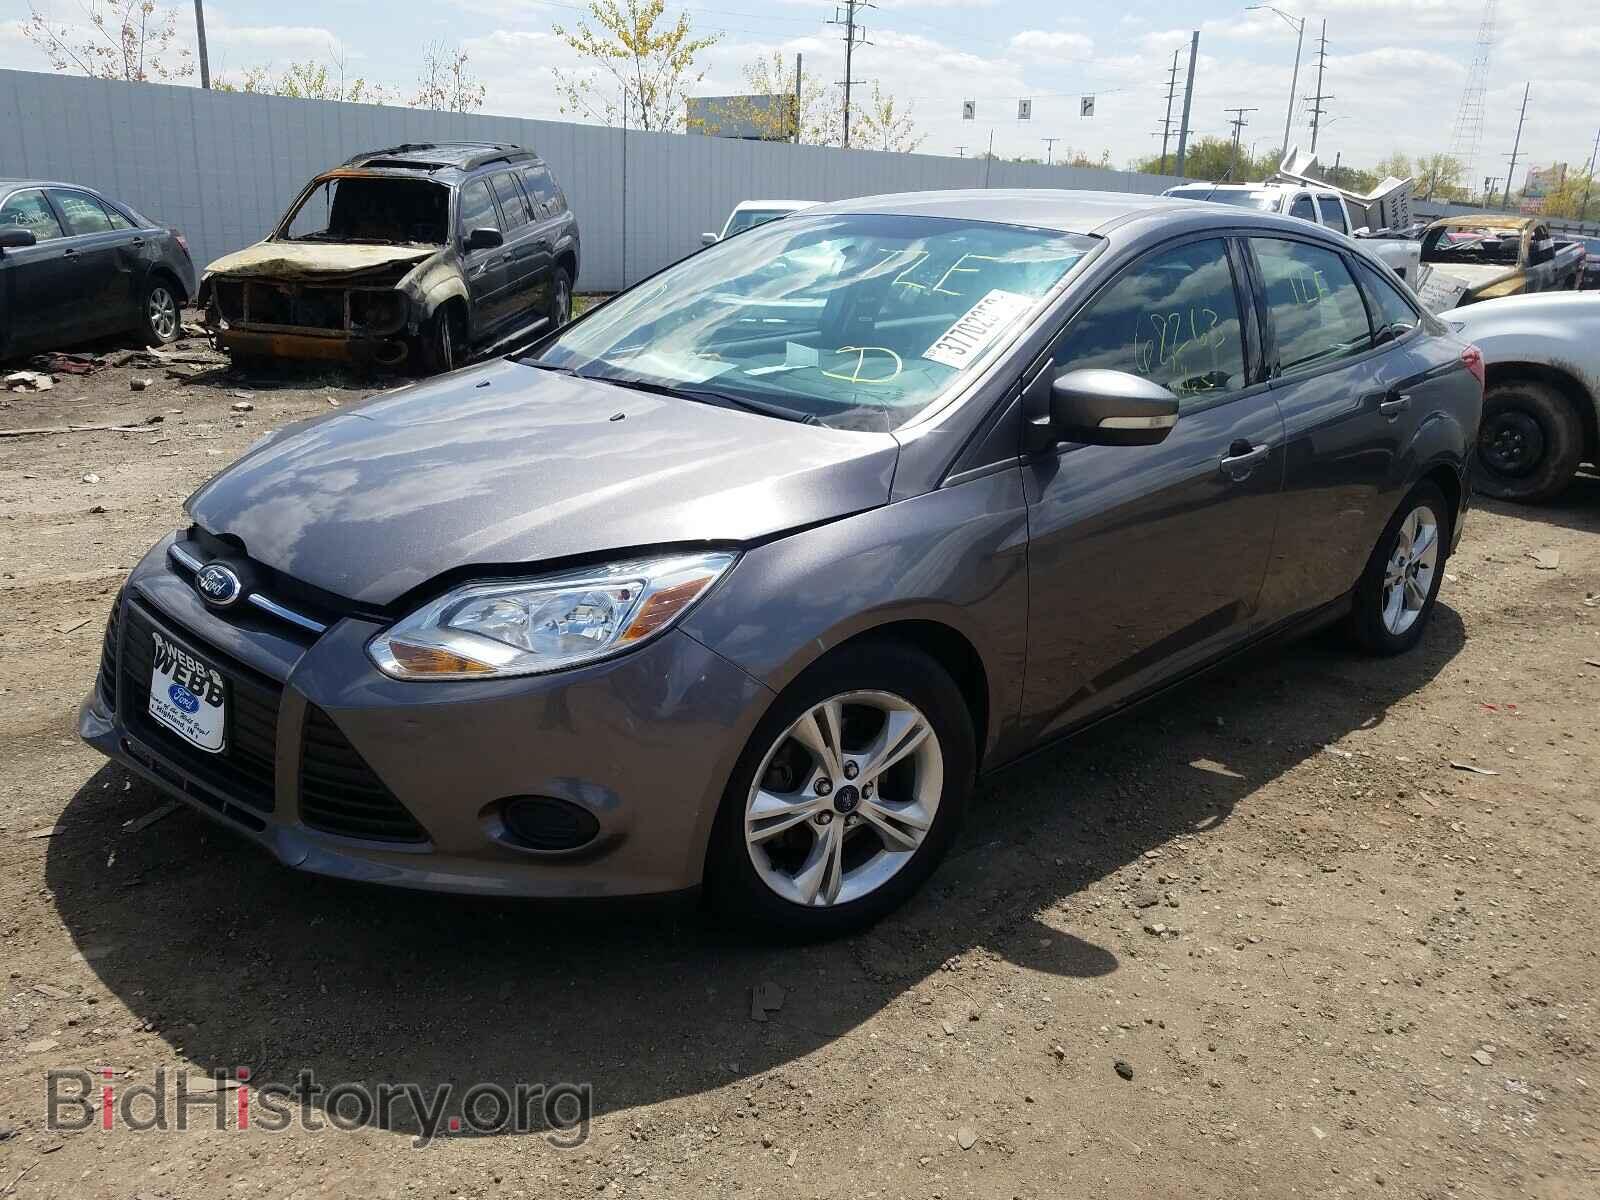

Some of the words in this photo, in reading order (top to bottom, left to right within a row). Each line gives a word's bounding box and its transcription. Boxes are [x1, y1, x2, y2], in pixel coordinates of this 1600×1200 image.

[200, 569, 227, 596] Ford
[153, 644, 224, 708] WEBB
[173, 687, 194, 709] Ford
[156, 704, 185, 731] Highland,
[185, 726, 194, 736] IN
